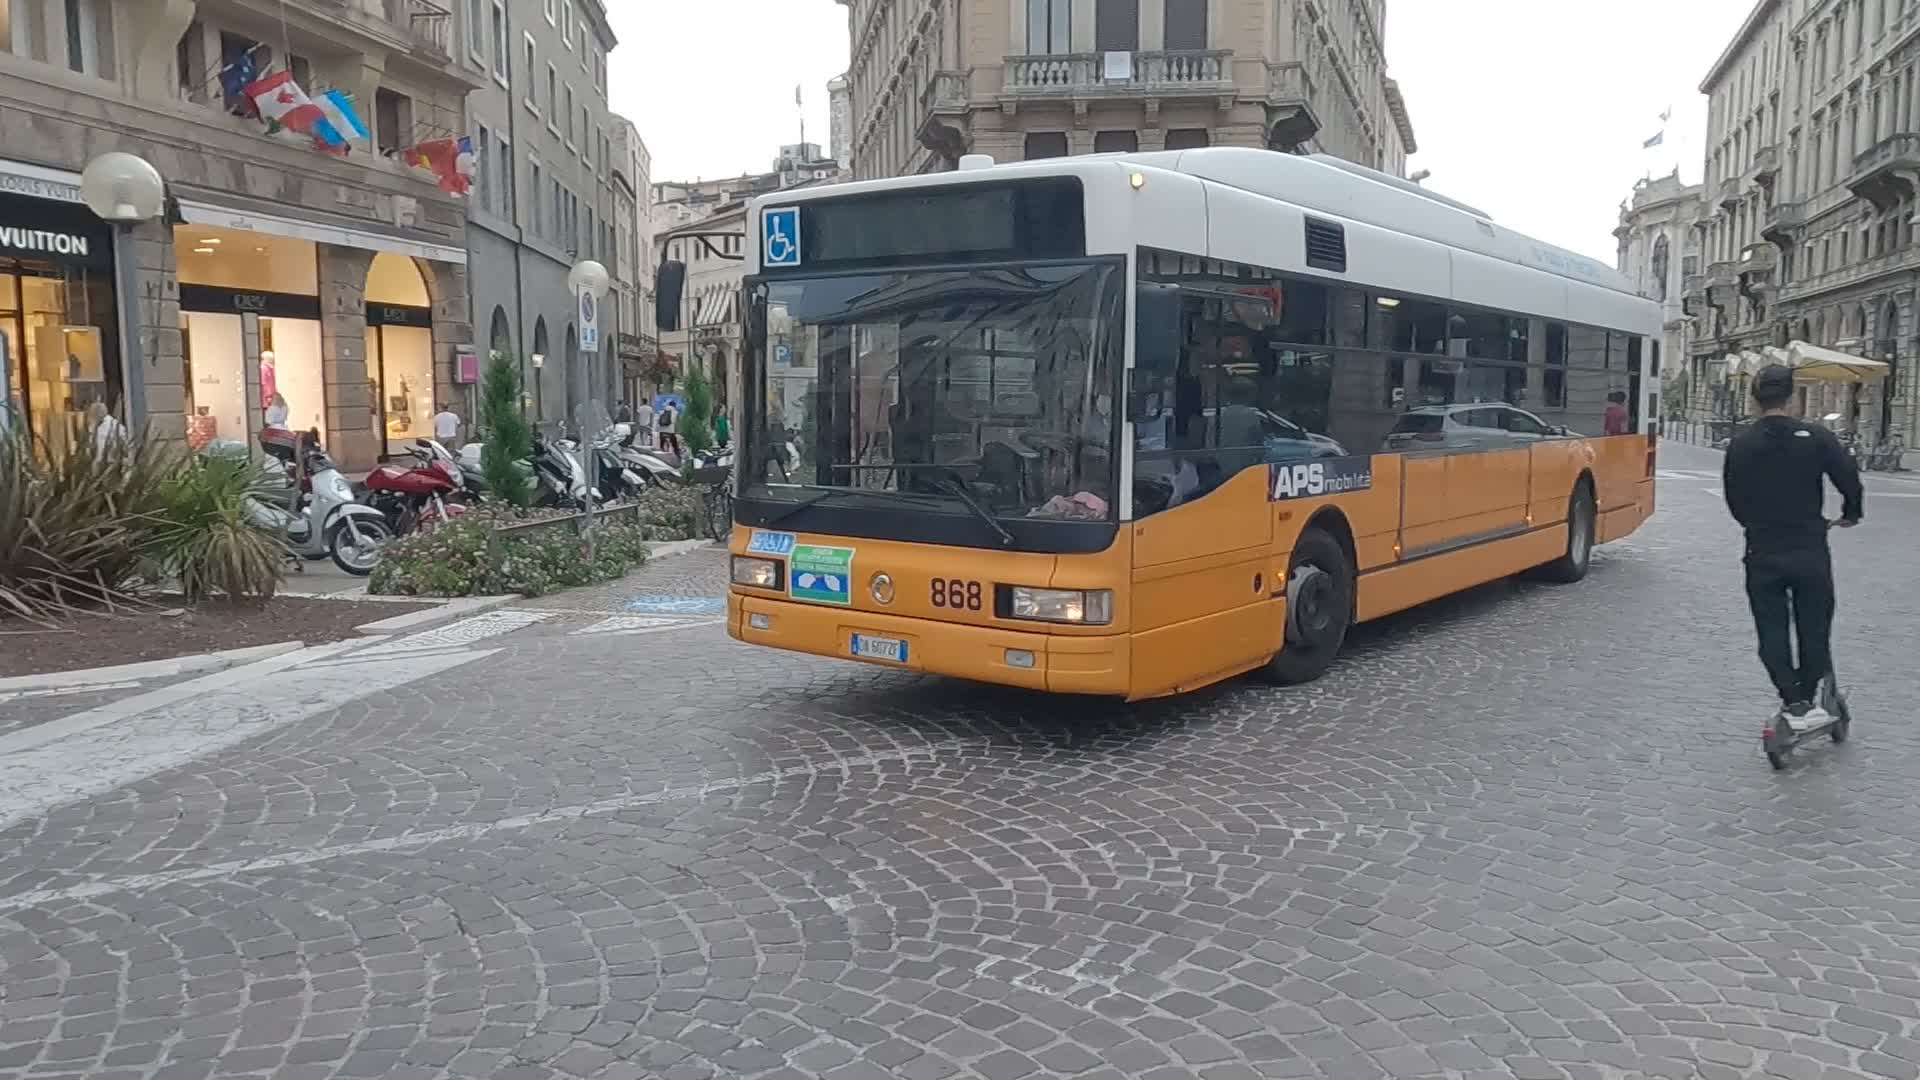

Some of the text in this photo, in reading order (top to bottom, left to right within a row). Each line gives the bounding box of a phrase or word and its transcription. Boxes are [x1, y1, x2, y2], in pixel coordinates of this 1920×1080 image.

[0, 226, 88, 255] VUITTON
[1274, 463, 1324, 499] APS
[931, 577, 982, 611] 868
